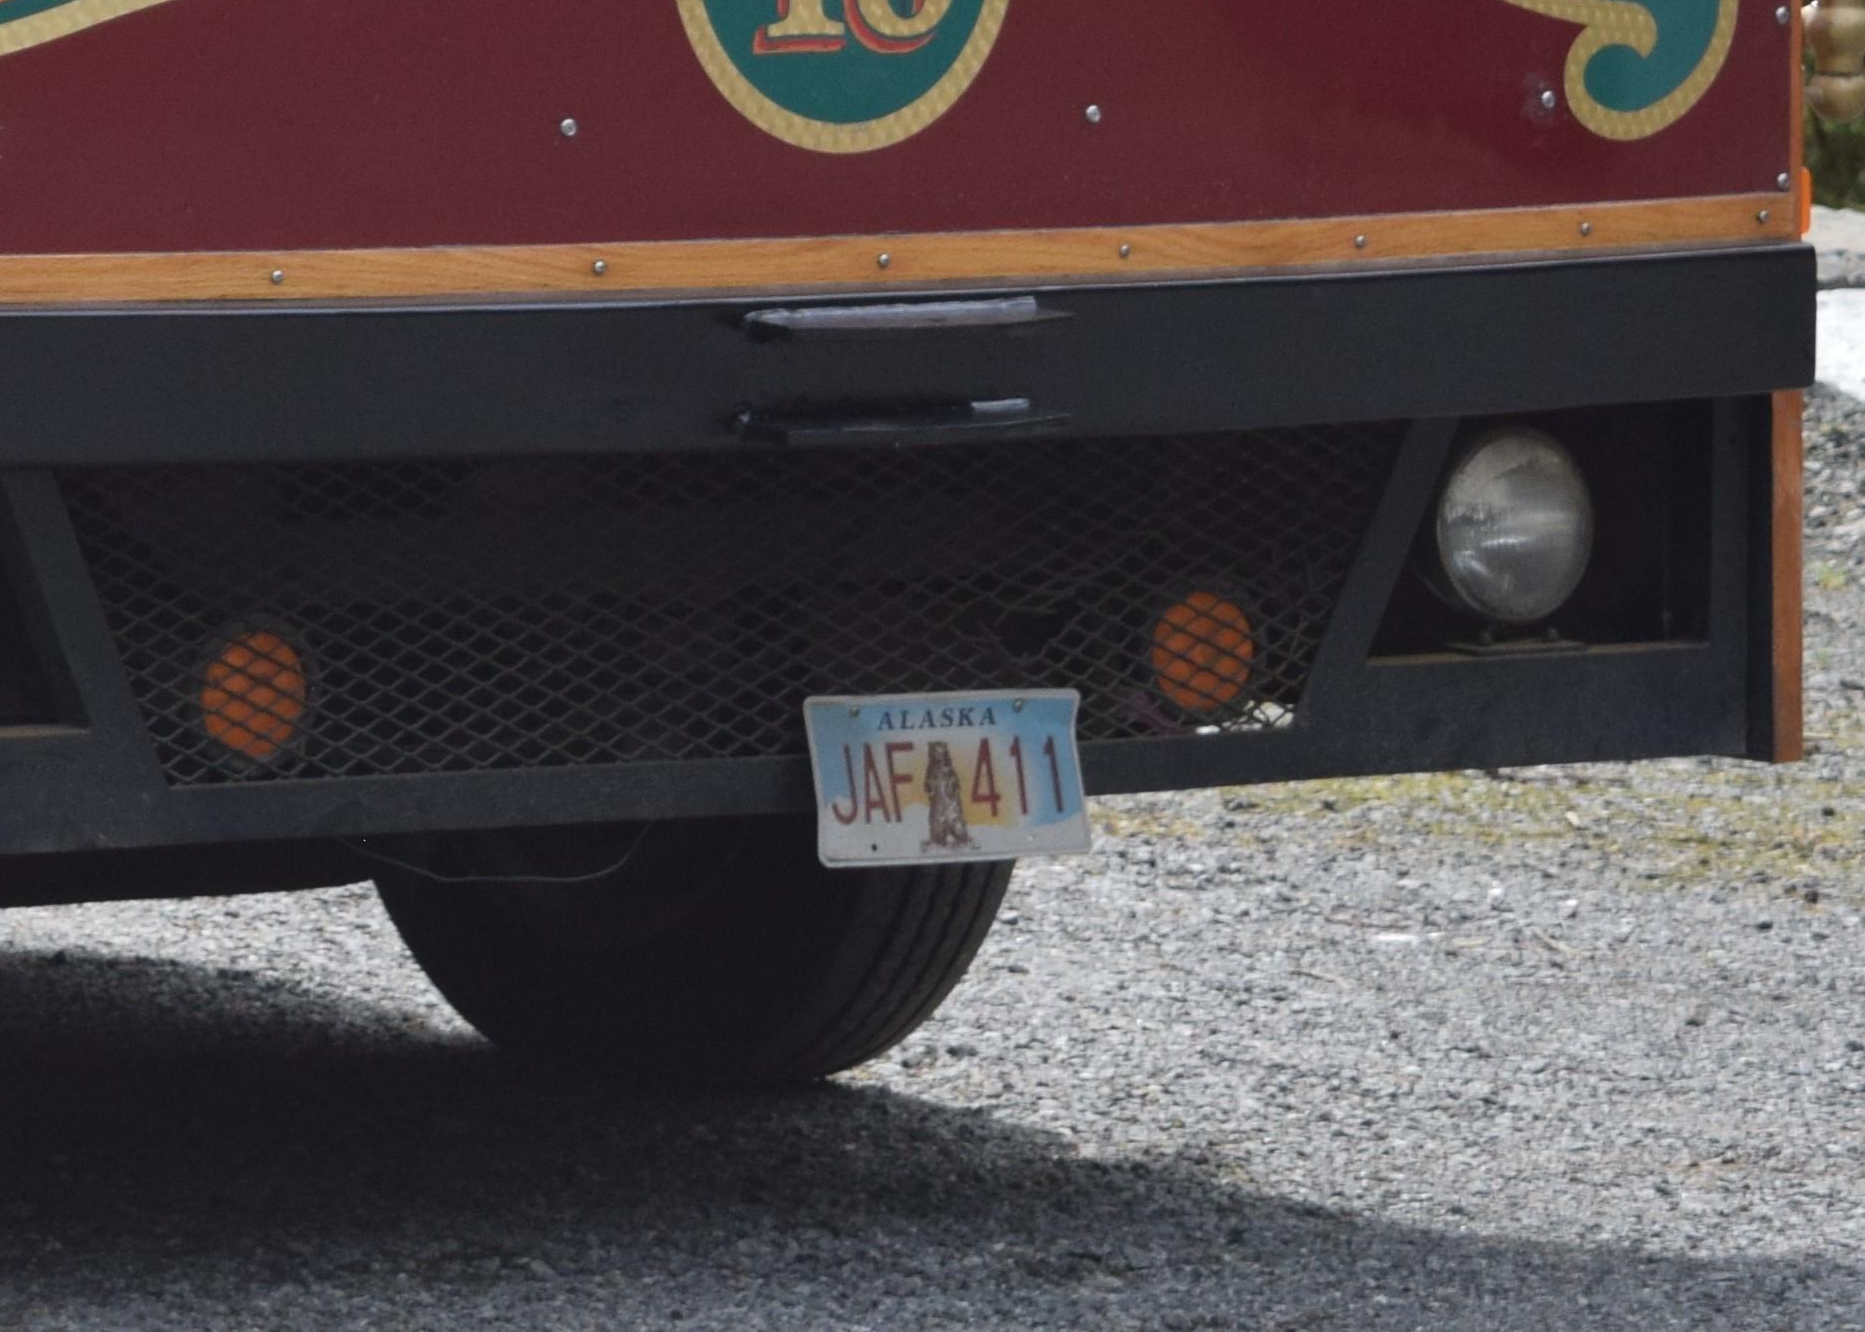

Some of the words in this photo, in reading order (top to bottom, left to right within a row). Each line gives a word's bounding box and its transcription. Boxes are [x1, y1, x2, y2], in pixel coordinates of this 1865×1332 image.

[877, 706, 997, 731] ALASKA
[831, 741, 914, 825] JAF
[971, 734, 1064, 818] 411
